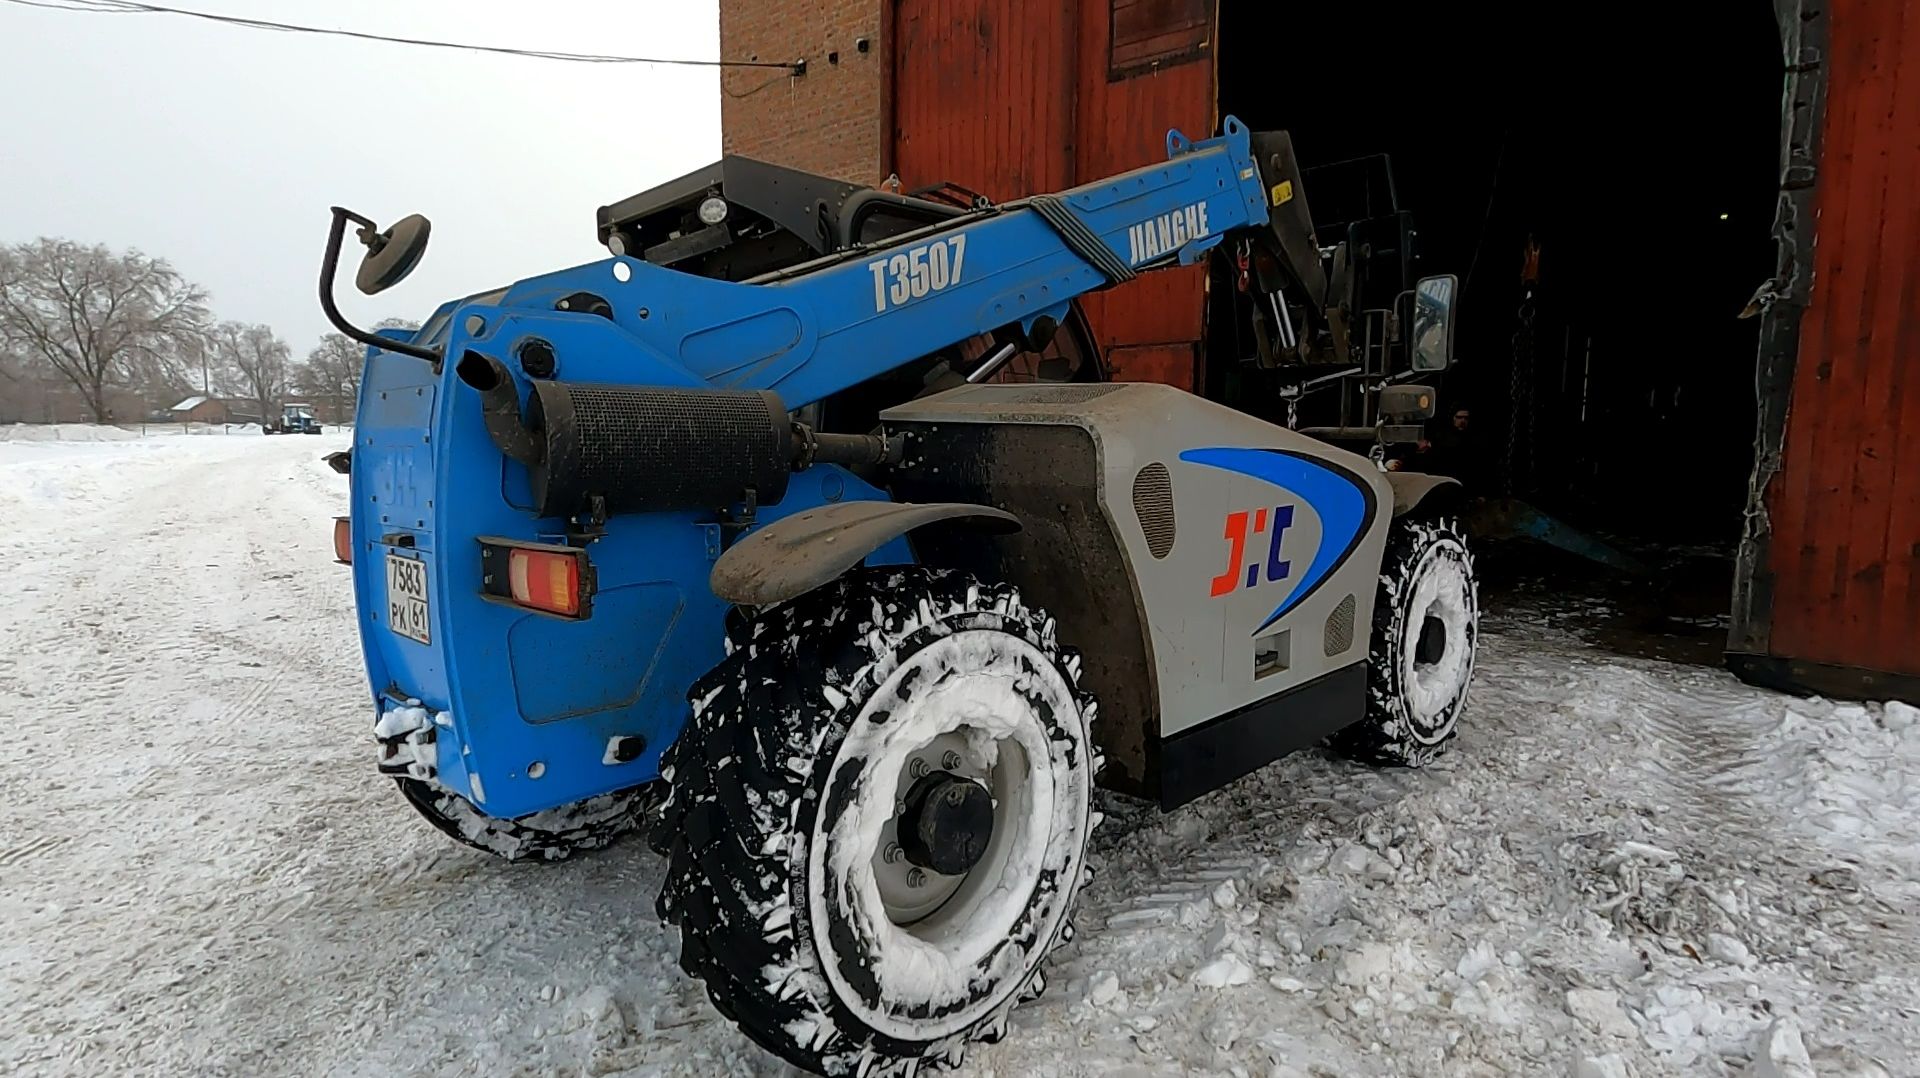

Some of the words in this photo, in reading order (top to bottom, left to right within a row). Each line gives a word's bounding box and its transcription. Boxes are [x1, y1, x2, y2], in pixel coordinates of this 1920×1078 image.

[1129, 201, 1209, 267] JIANGHE
[869, 232, 966, 313] T3507
[390, 559, 421, 596] 7583
[412, 602, 426, 630] 61
